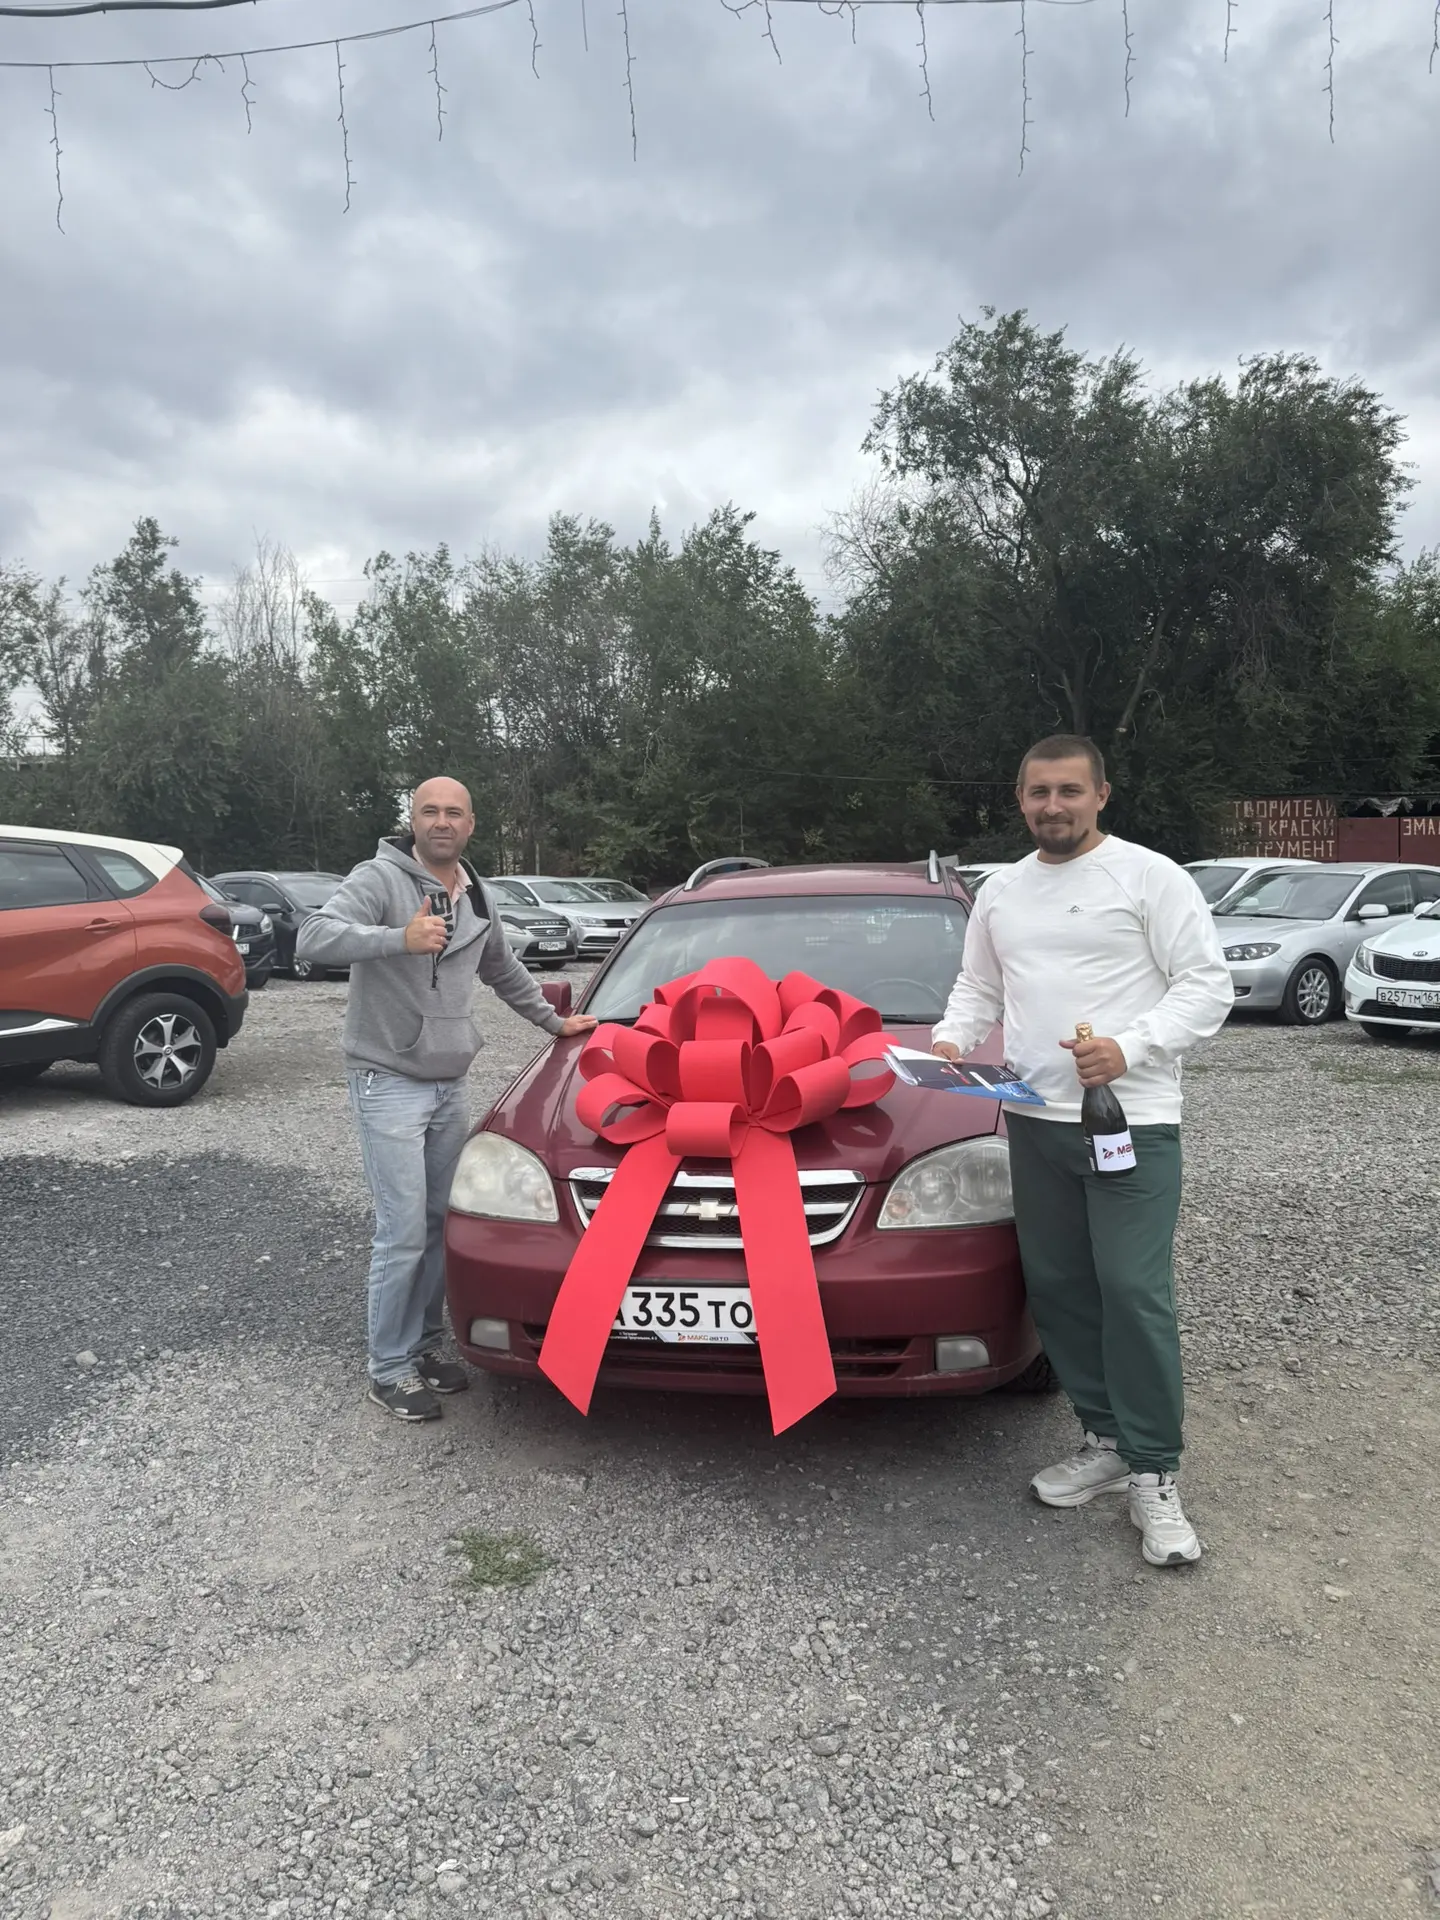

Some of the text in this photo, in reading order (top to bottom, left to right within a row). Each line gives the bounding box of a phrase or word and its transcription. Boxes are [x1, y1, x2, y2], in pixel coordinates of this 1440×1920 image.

[1226, 799, 1337, 818] ТВОРИТЕЛИ
[1268, 819, 1334, 837] КРАСКИ
[1239, 840, 1335, 858] ТРУМЕНТ
